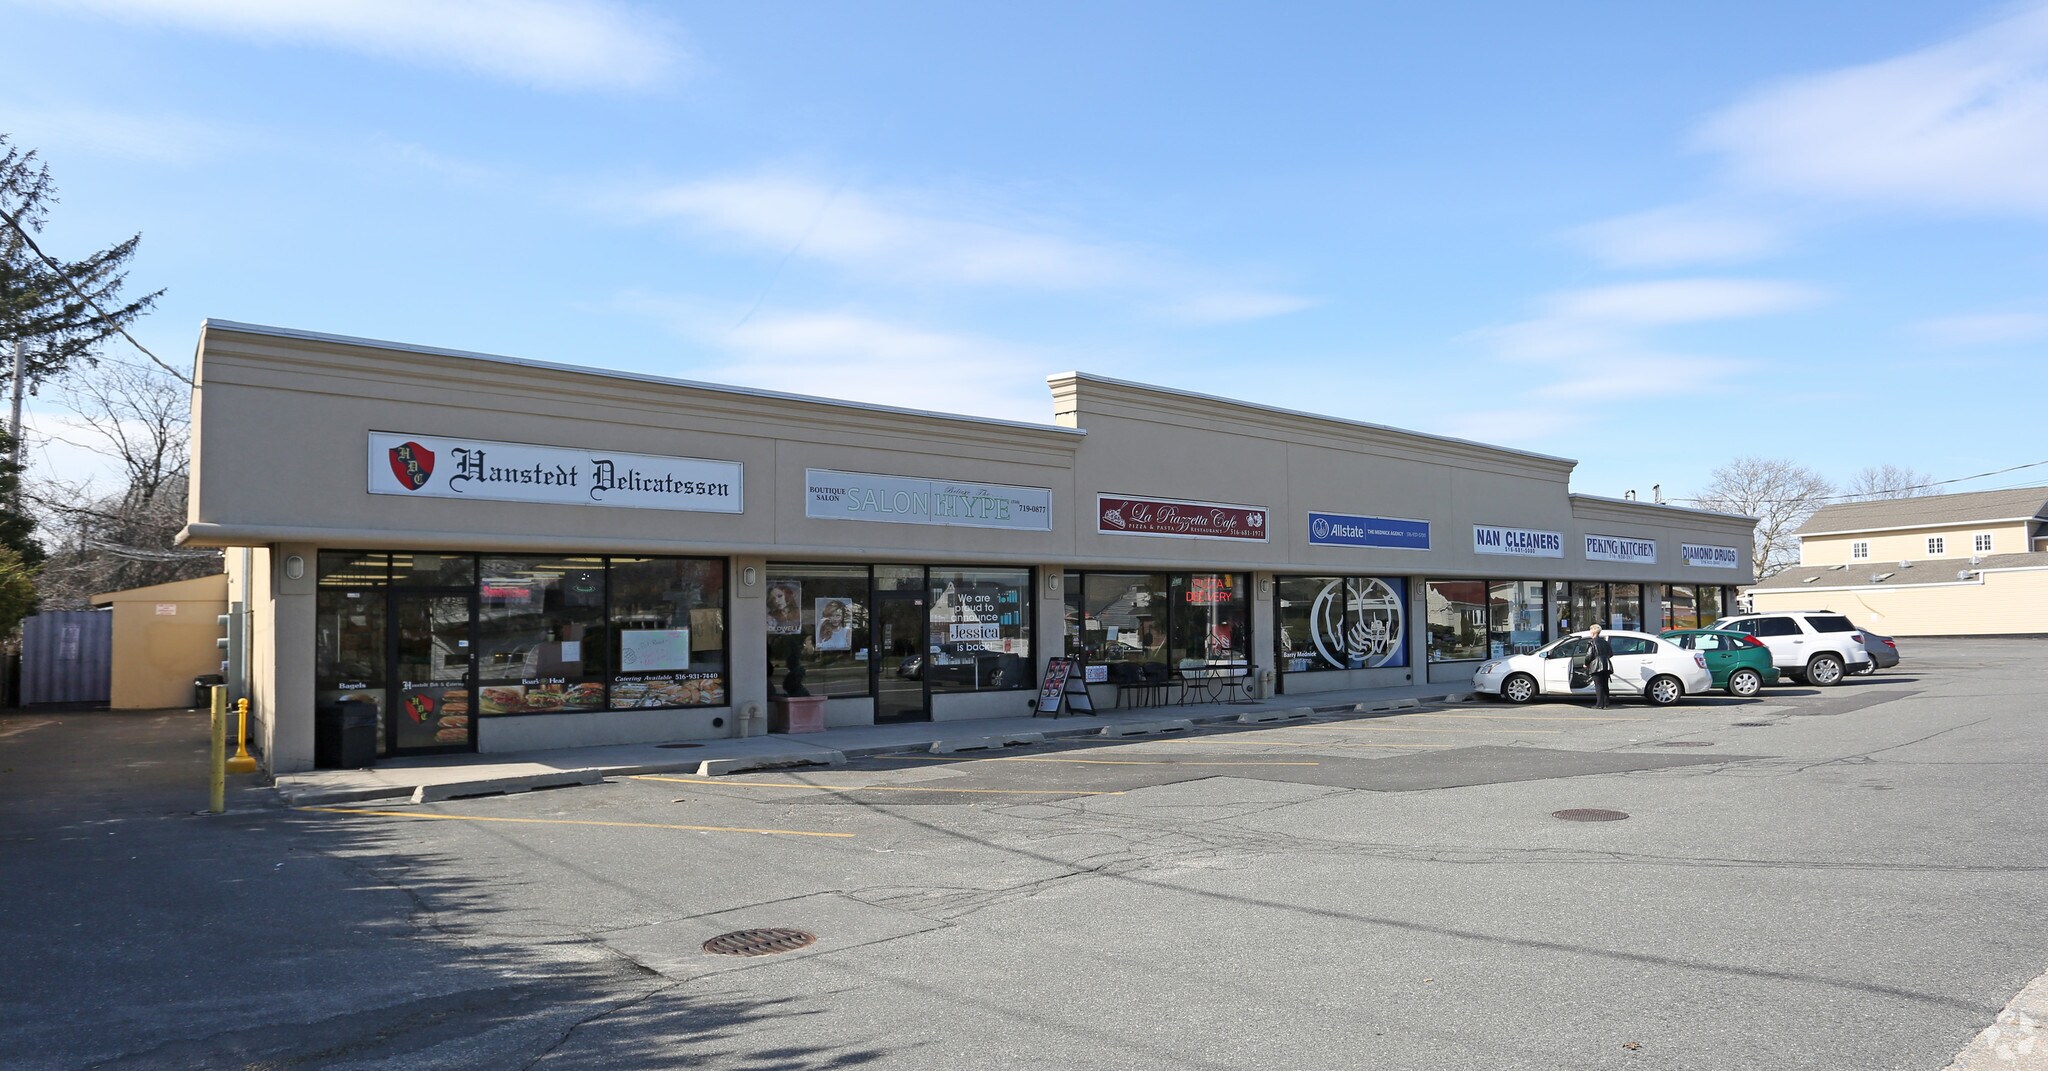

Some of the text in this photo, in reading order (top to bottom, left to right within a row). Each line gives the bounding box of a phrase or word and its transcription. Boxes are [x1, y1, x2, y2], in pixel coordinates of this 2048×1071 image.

[449, 447, 729, 501] Hanstedt Delicatessen
[809, 486, 847, 495] BOUTIQUE
[847, 486, 929, 516] SALON
[1019, 504, 1046, 514] 719-0877
[1130, 502, 1238, 534] La Piazzetta Cafe
[1331, 524, 1364, 538] Allstate
[1477, 529, 1560, 550] NAN CLEANERS
[1586, 538, 1618, 555] PEKING
[1620, 541, 1654, 557] KITCHEN
[1682, 546, 1736, 562] DIAMOND DRUGS
[957, 593, 972, 602] We
[955, 603, 994, 614] proud to
[950, 612, 998, 622] announce
[951, 625, 999, 639] Jessica
[956, 643, 964, 652] is
[338, 682, 367, 690] Bagels
